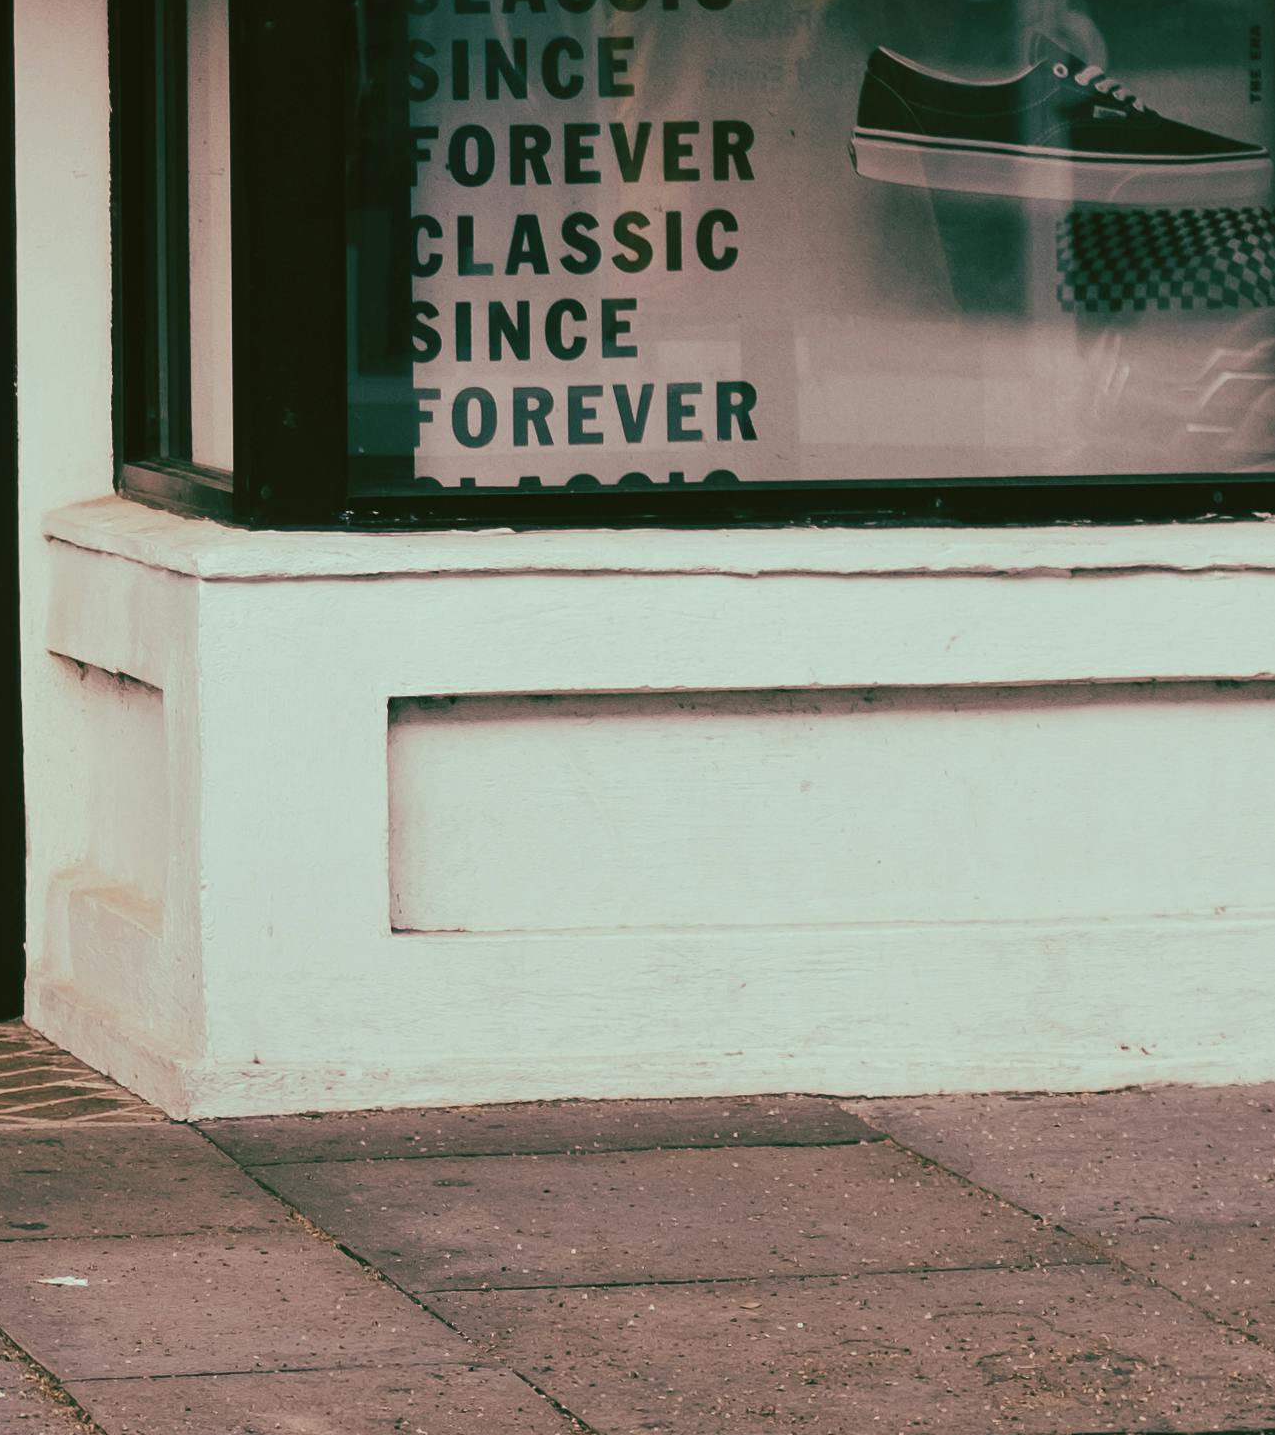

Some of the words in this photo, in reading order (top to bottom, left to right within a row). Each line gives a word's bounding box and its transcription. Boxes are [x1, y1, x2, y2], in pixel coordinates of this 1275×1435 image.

[407, 37, 636, 101] SINCE
[411, 209, 741, 277] CLASSIC
[412, 298, 640, 363] SINCE
